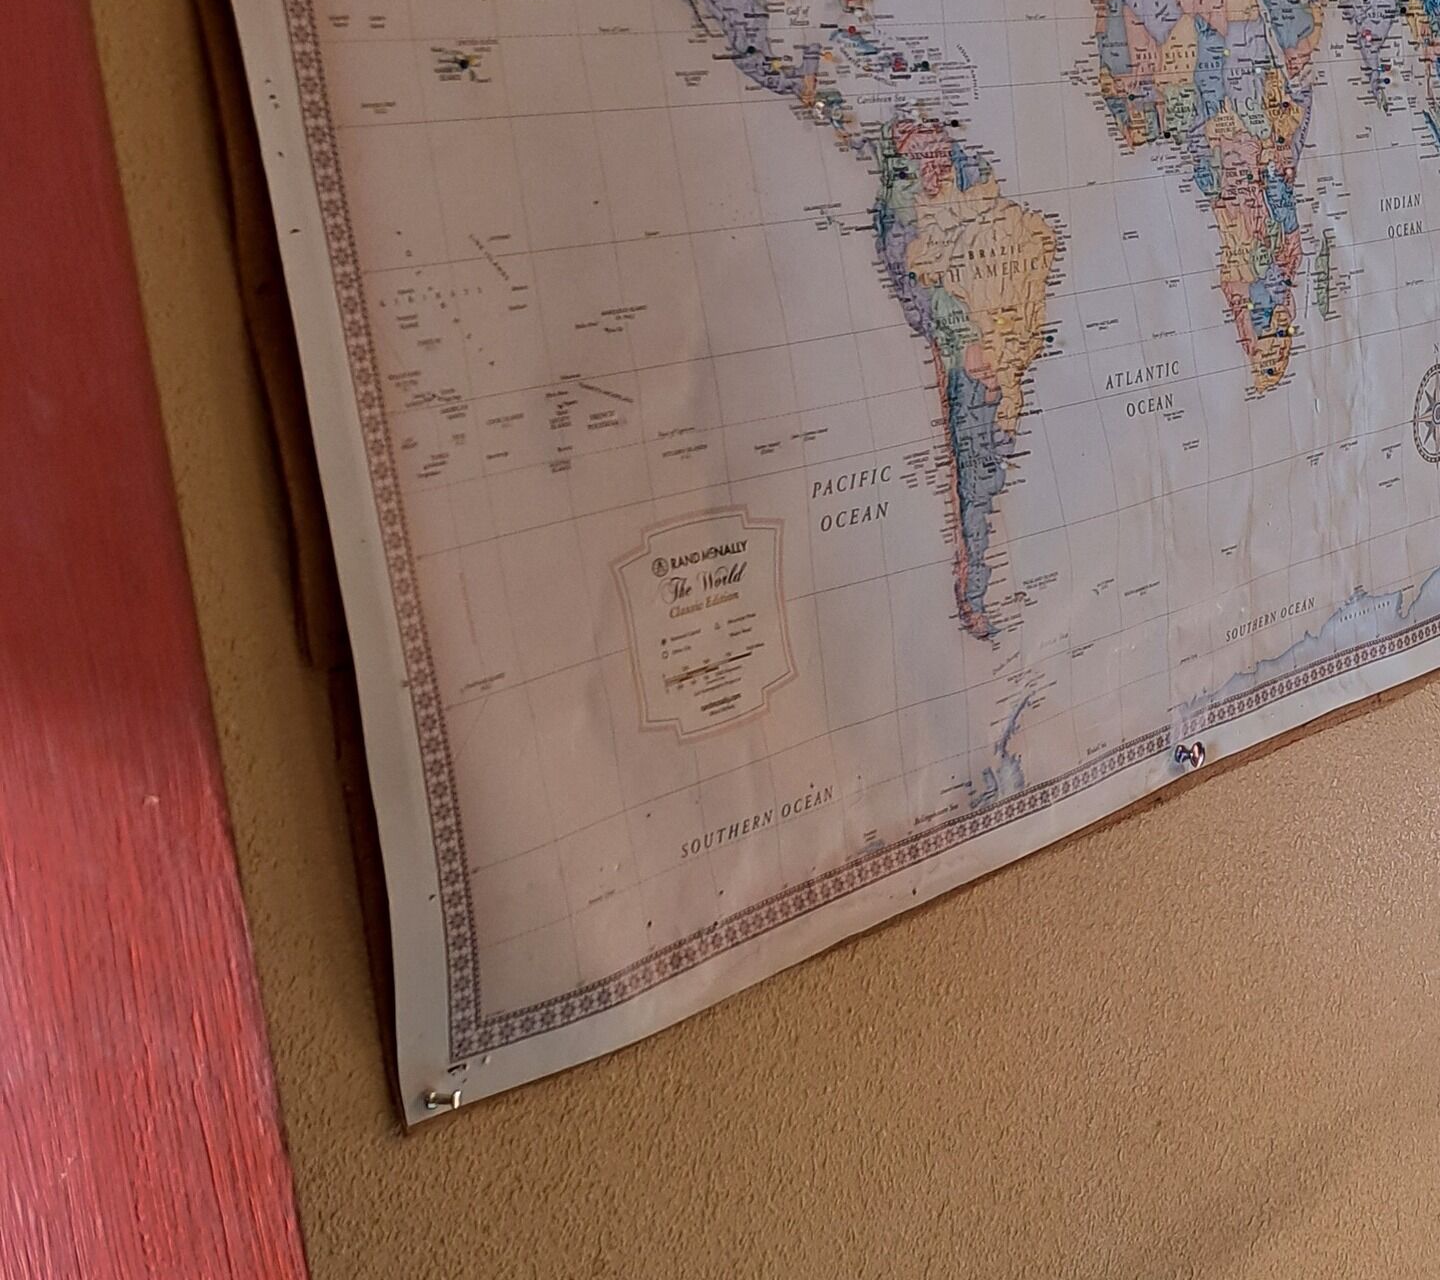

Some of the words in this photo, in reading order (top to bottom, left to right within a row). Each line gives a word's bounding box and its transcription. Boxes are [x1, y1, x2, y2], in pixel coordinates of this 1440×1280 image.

[1380, 193, 1421, 212] INDIAN
[1387, 221, 1423, 239] OCEAN
[1105, 360, 1180, 390] ATLANTIC
[1126, 394, 1174, 418] OCEAN
[811, 465, 892, 498] PACIFIC
[820, 501, 889, 532] OCEAN
[670, 551, 700, 568] RAND
[659, 576, 692, 605] The
[696, 561, 748, 591] World
[1225, 609, 1277, 643] SOUTHERN
[1279, 597, 1316, 619] OCEAN
[680, 810, 774, 859] SOUTHERN
[781, 785, 834, 818] OCEAN
